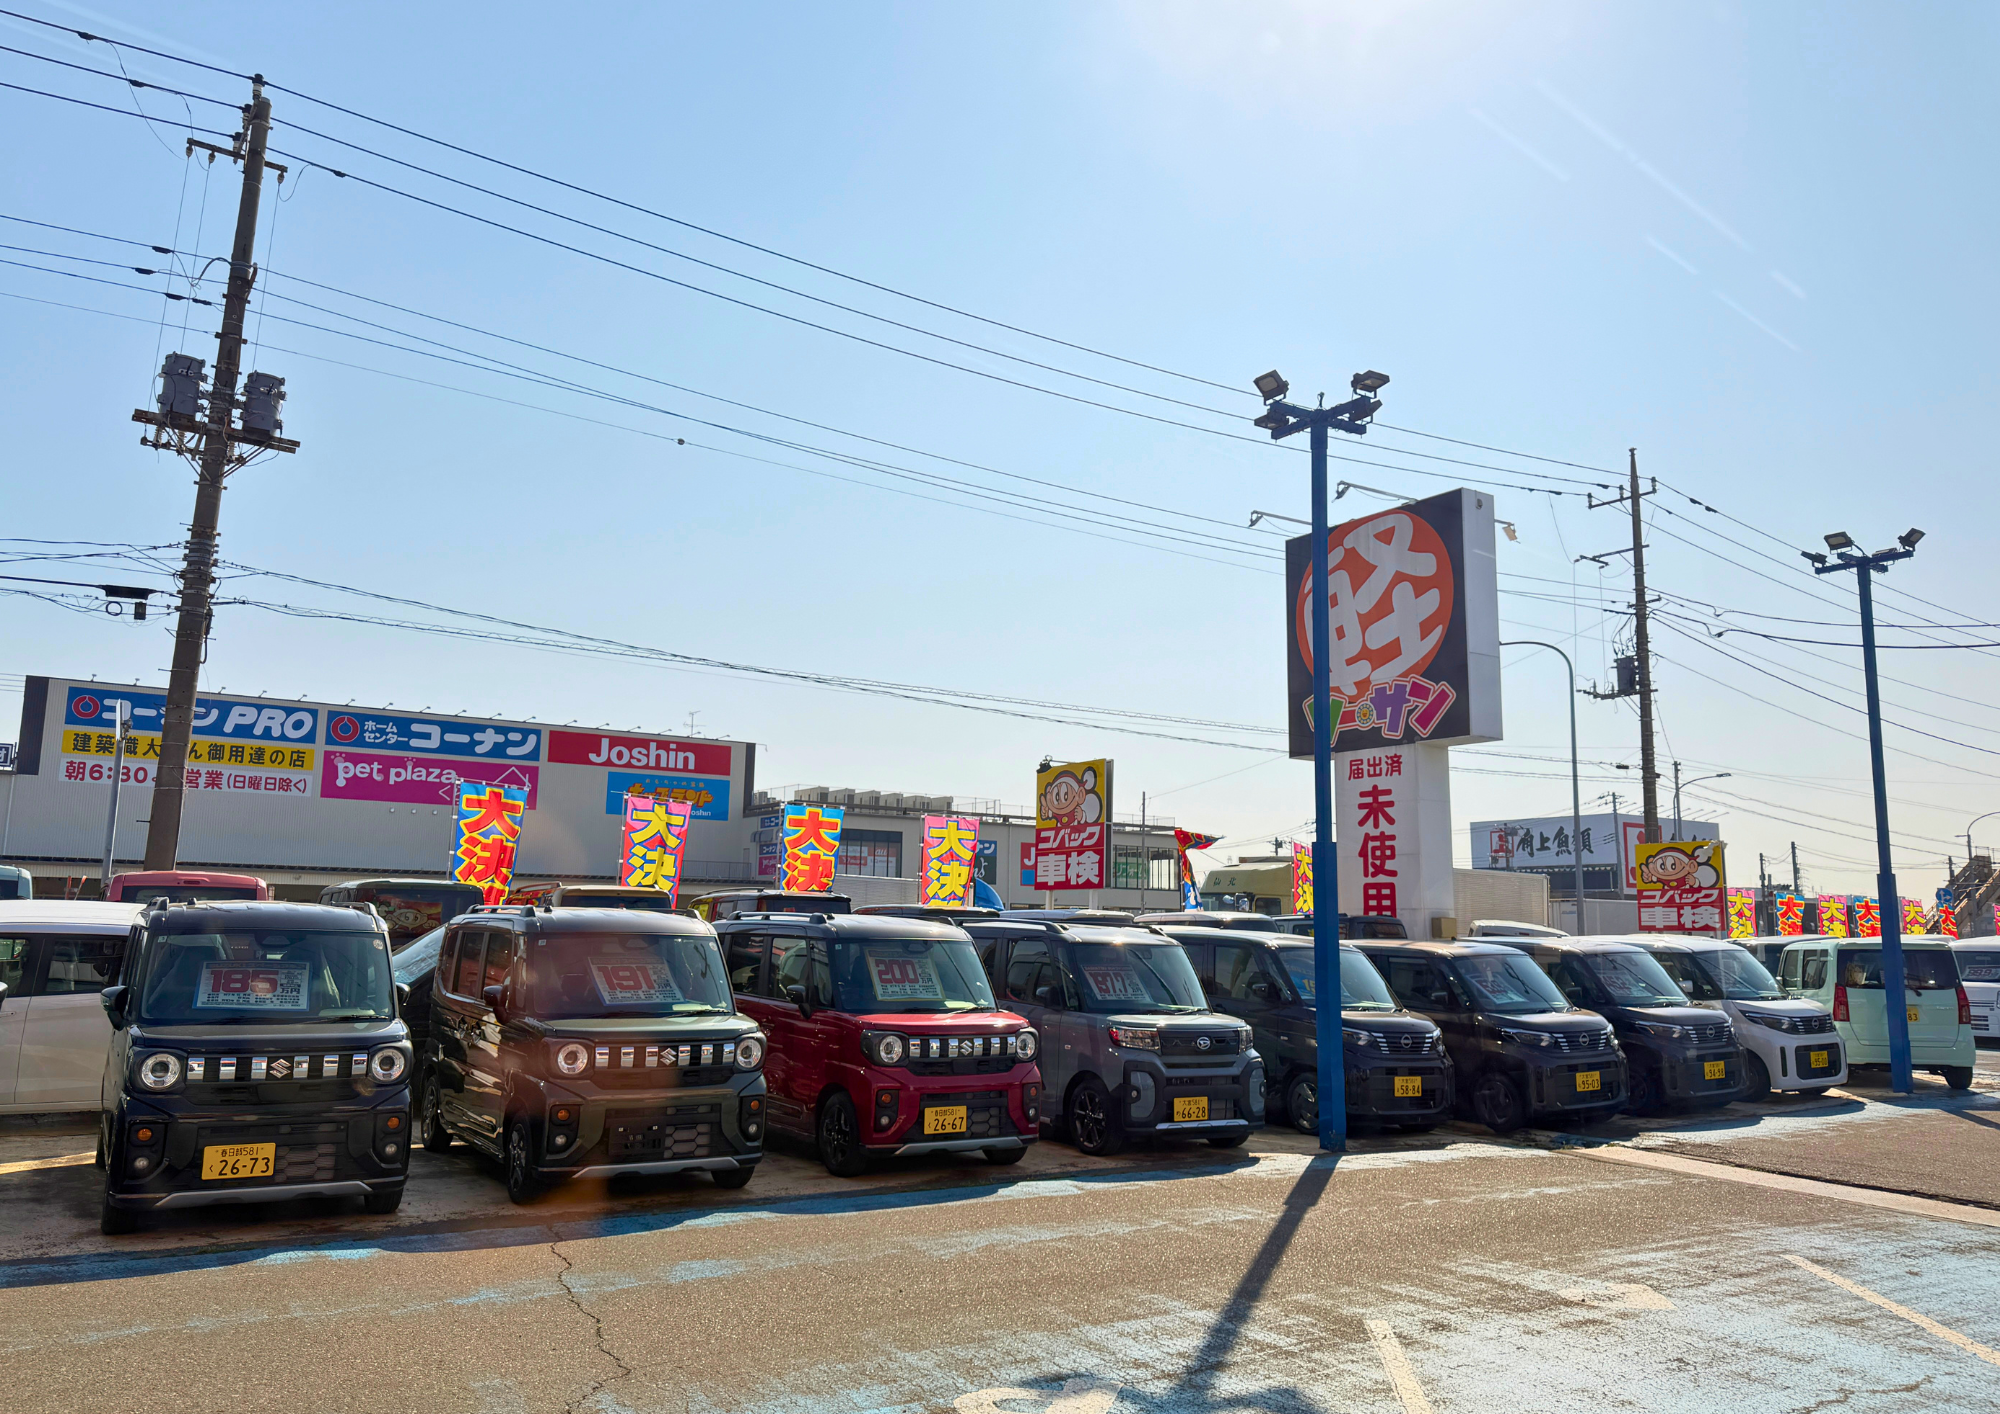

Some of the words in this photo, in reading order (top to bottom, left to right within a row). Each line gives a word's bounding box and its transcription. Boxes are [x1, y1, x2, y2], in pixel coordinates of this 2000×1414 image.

[101, 698, 219, 728] コーン
[223, 705, 313, 739] PRO
[364, 720, 398, 733] ホーム
[364, 731, 408, 744] センター
[409, 723, 537, 756] コーナン
[588, 738, 696, 770] Joshin
[335, 761, 384, 787] pet
[389, 763, 457, 785] plaza
[1348, 753, 1403, 781] 届出済
[1038, 826, 1101, 849] コバック
[1516, 825, 1594, 858] 角上魚類
[1036, 851, 1101, 886] 車検
[1640, 889, 1720, 904] コバック
[1640, 905, 1721, 929] 車検
[210, 970, 279, 993] 185
[597, 966, 655, 990] 191
[875, 959, 919, 984] 200
[1400, 1084, 1420, 1095] 58-84
[1581, 1078, 1600, 1089] 95-03
[934, 1117, 964, 1131] 26-67
[1181, 1106, 1205, 1119] 66-28
[218, 1157, 270, 1176] 26-73
